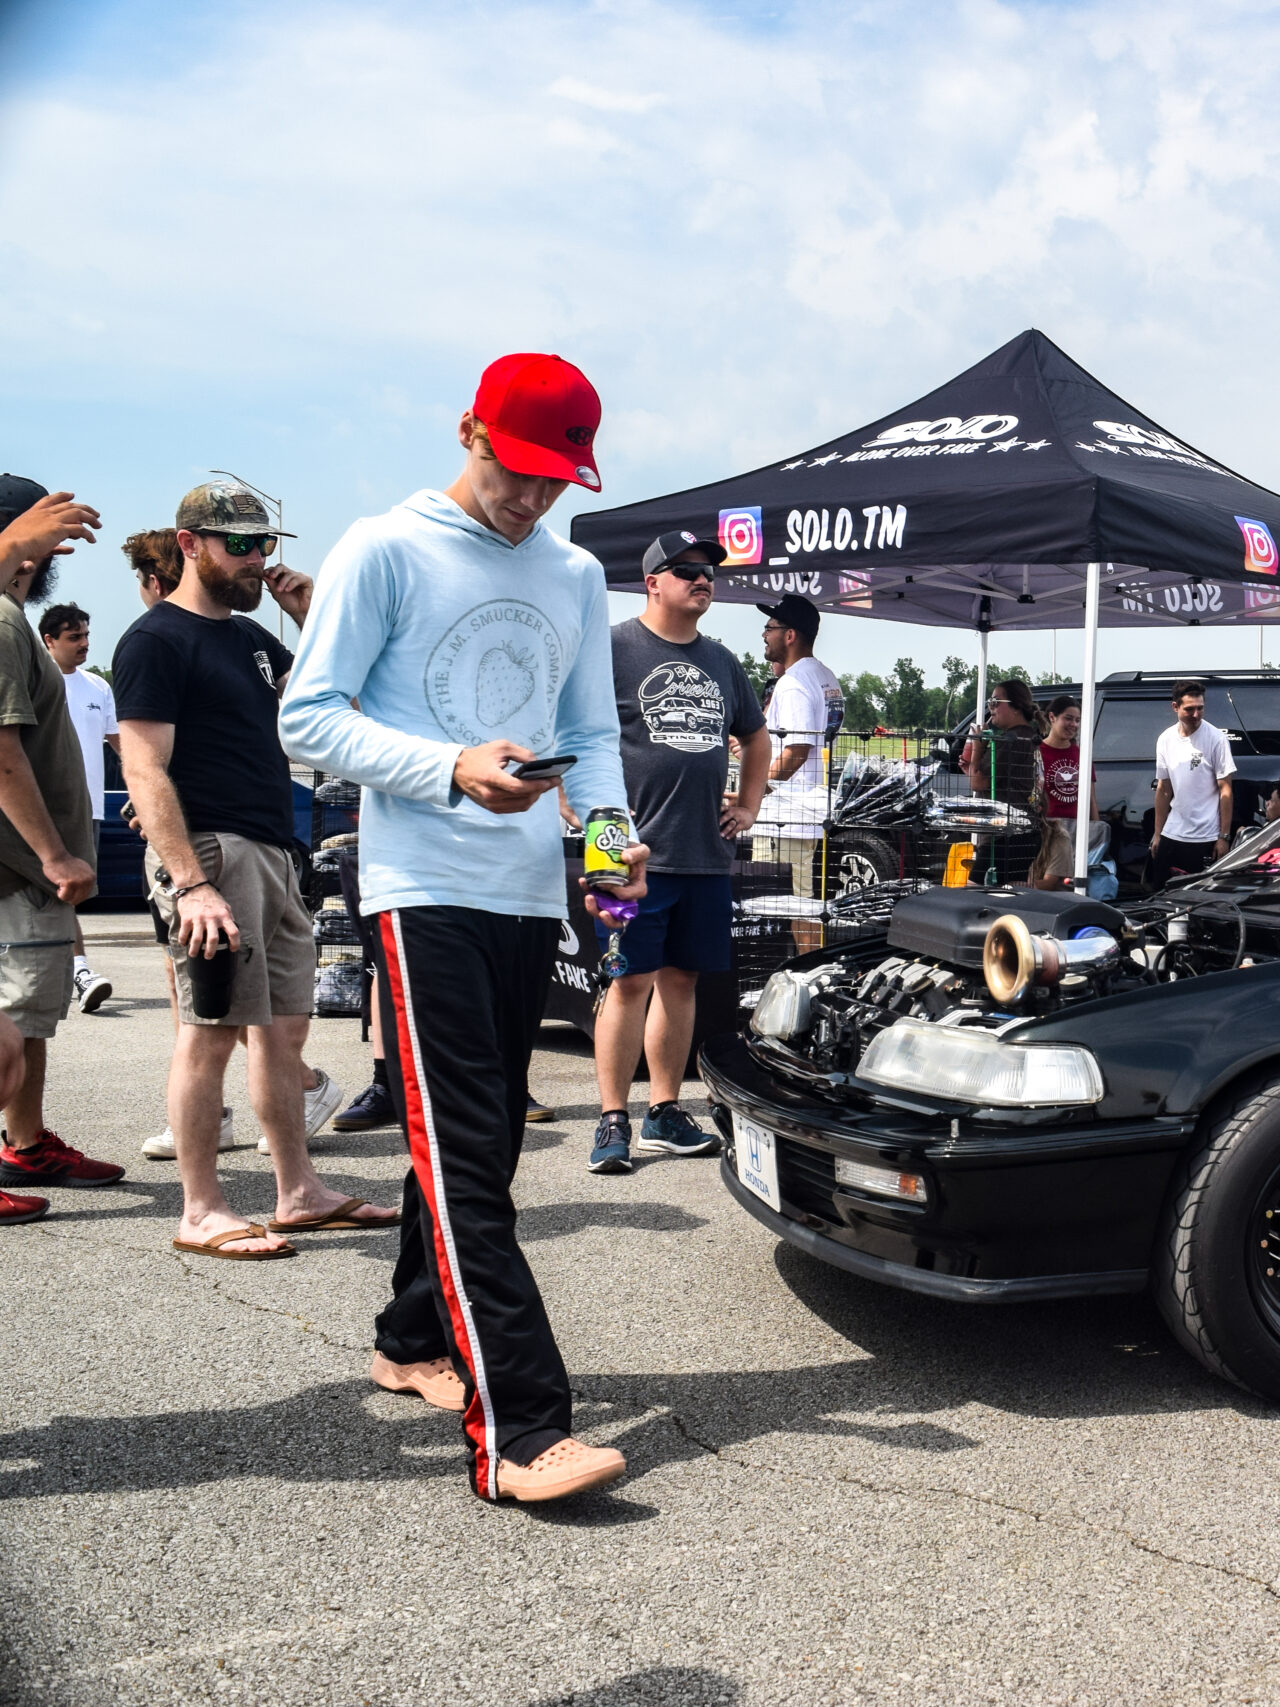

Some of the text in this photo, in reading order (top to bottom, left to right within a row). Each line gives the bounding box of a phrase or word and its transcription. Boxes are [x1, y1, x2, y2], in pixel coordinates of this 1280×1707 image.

[861, 414, 1019, 448] SOLO
[840, 442, 986, 463] ALONE OVER FAKE
[435, 670, 451, 708] THE
[470, 608, 543, 634] SMUCKER
[638, 668, 724, 702] Corvette
[700, 699, 720, 710] 1963
[529, 728, 547, 745] KY
[554, 961, 591, 993] FAKE
[745, 1168, 770, 1198] HONDA
